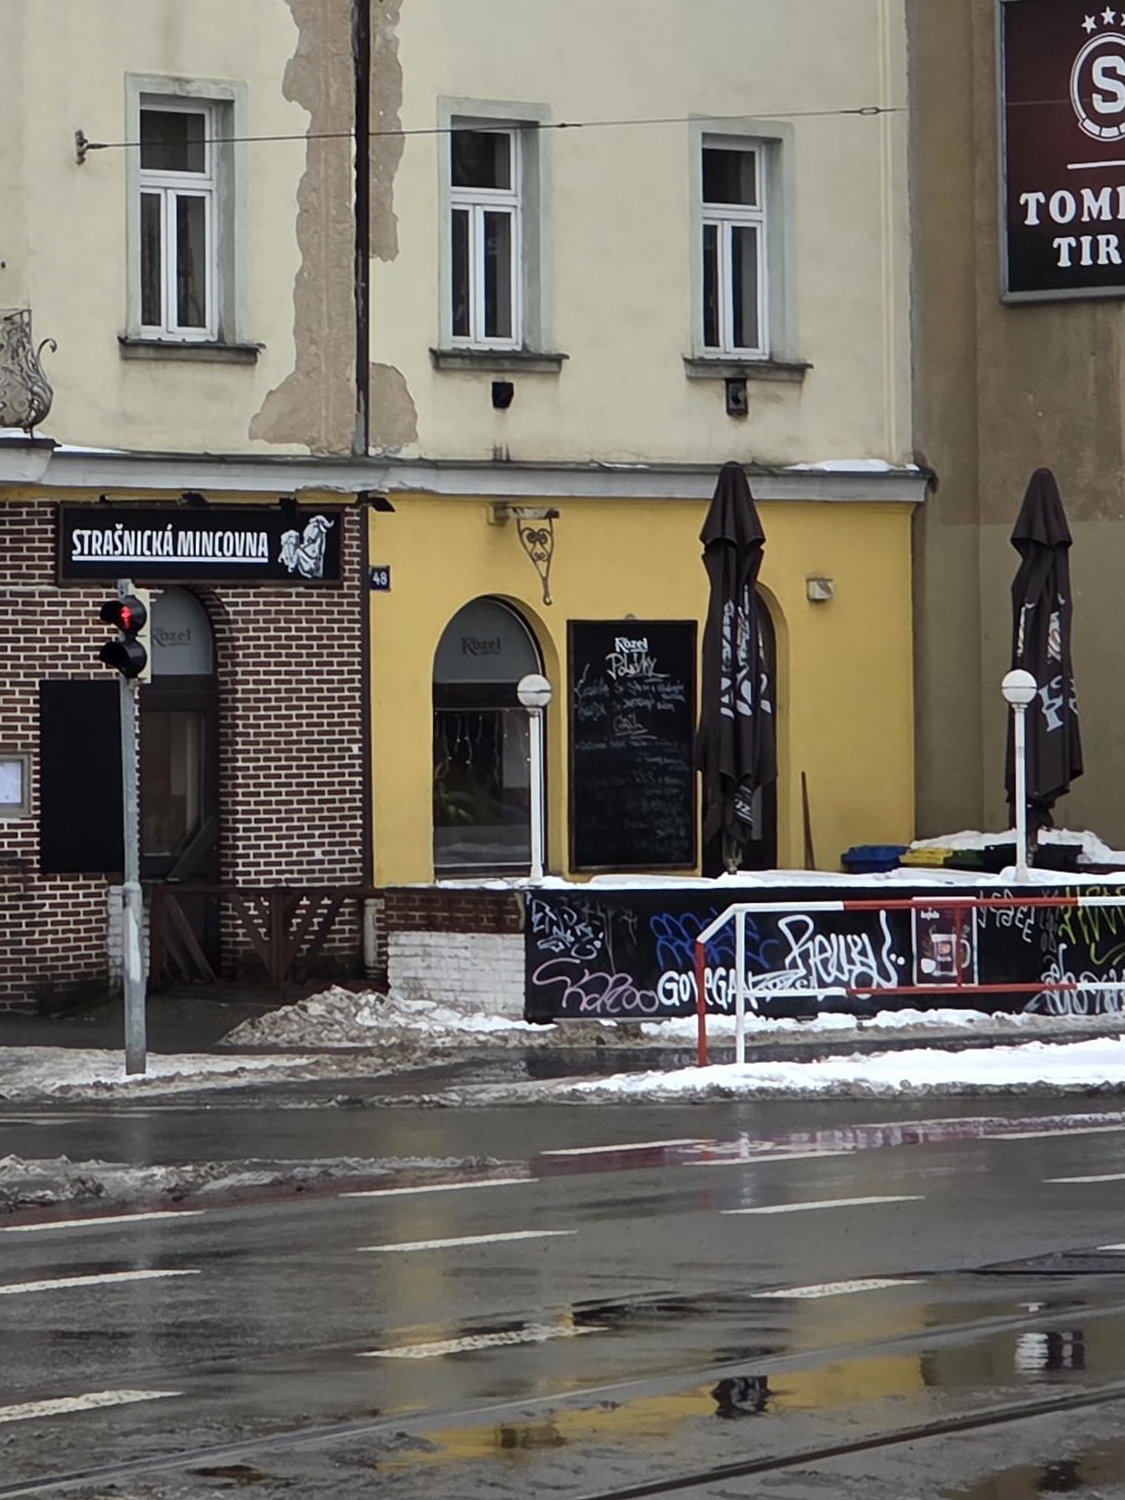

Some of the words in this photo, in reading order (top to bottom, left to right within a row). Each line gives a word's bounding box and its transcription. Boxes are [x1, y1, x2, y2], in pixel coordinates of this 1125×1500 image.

[1052, 233, 1123, 267] TIR
[72, 523, 174, 556] STRAŠNICKÁ
[177, 531, 268, 557] MINCOVNA
[373, 571, 387, 586] 48
